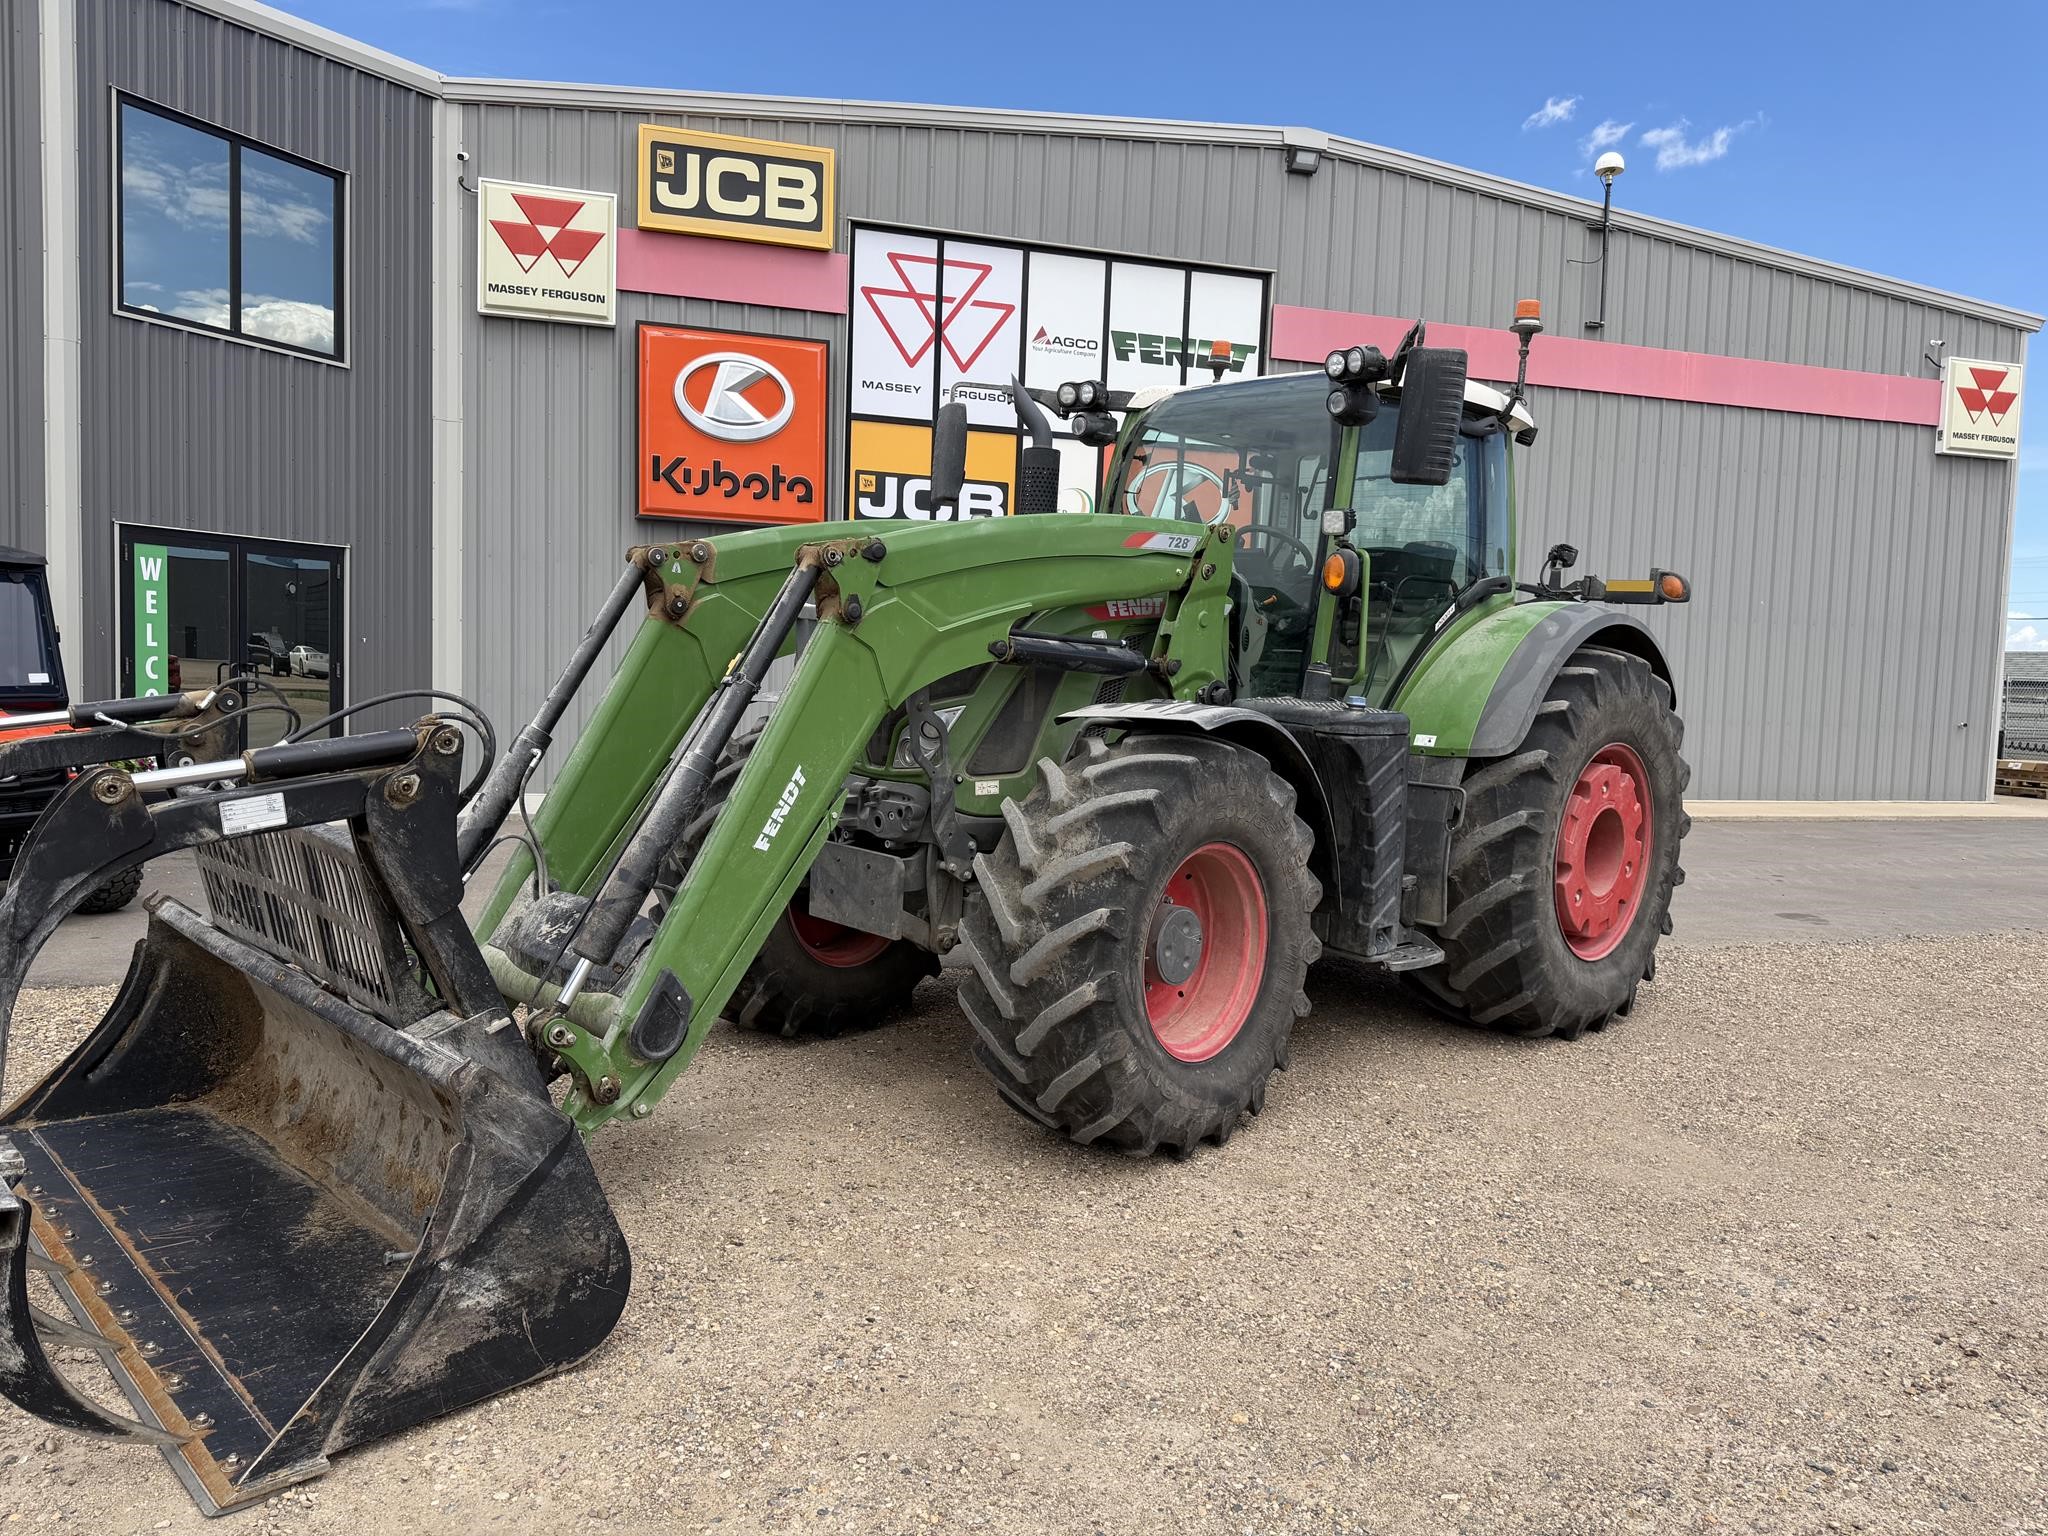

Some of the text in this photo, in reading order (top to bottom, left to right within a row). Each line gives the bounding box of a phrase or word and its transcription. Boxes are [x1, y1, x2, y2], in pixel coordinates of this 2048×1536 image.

[655, 153, 819, 224] JCB
[487, 283, 606, 304] MASSEY FERGUSON
[1052, 336, 1098, 349] AGCO
[1044, 346, 1072, 354] Agriculture
[1073, 349, 1096, 358] Company
[862, 380, 922, 394] MASSEY
[942, 388, 1008, 403] FRGUSO
[1952, 431, 1980, 441] MASSEY
[1981, 434, 2016, 445] FERGUSON
[651, 454, 814, 504] Kubota
[1168, 536, 1191, 549] 728
[1106, 597, 1164, 617] FENDT
[752, 764, 806, 852] FENDT
